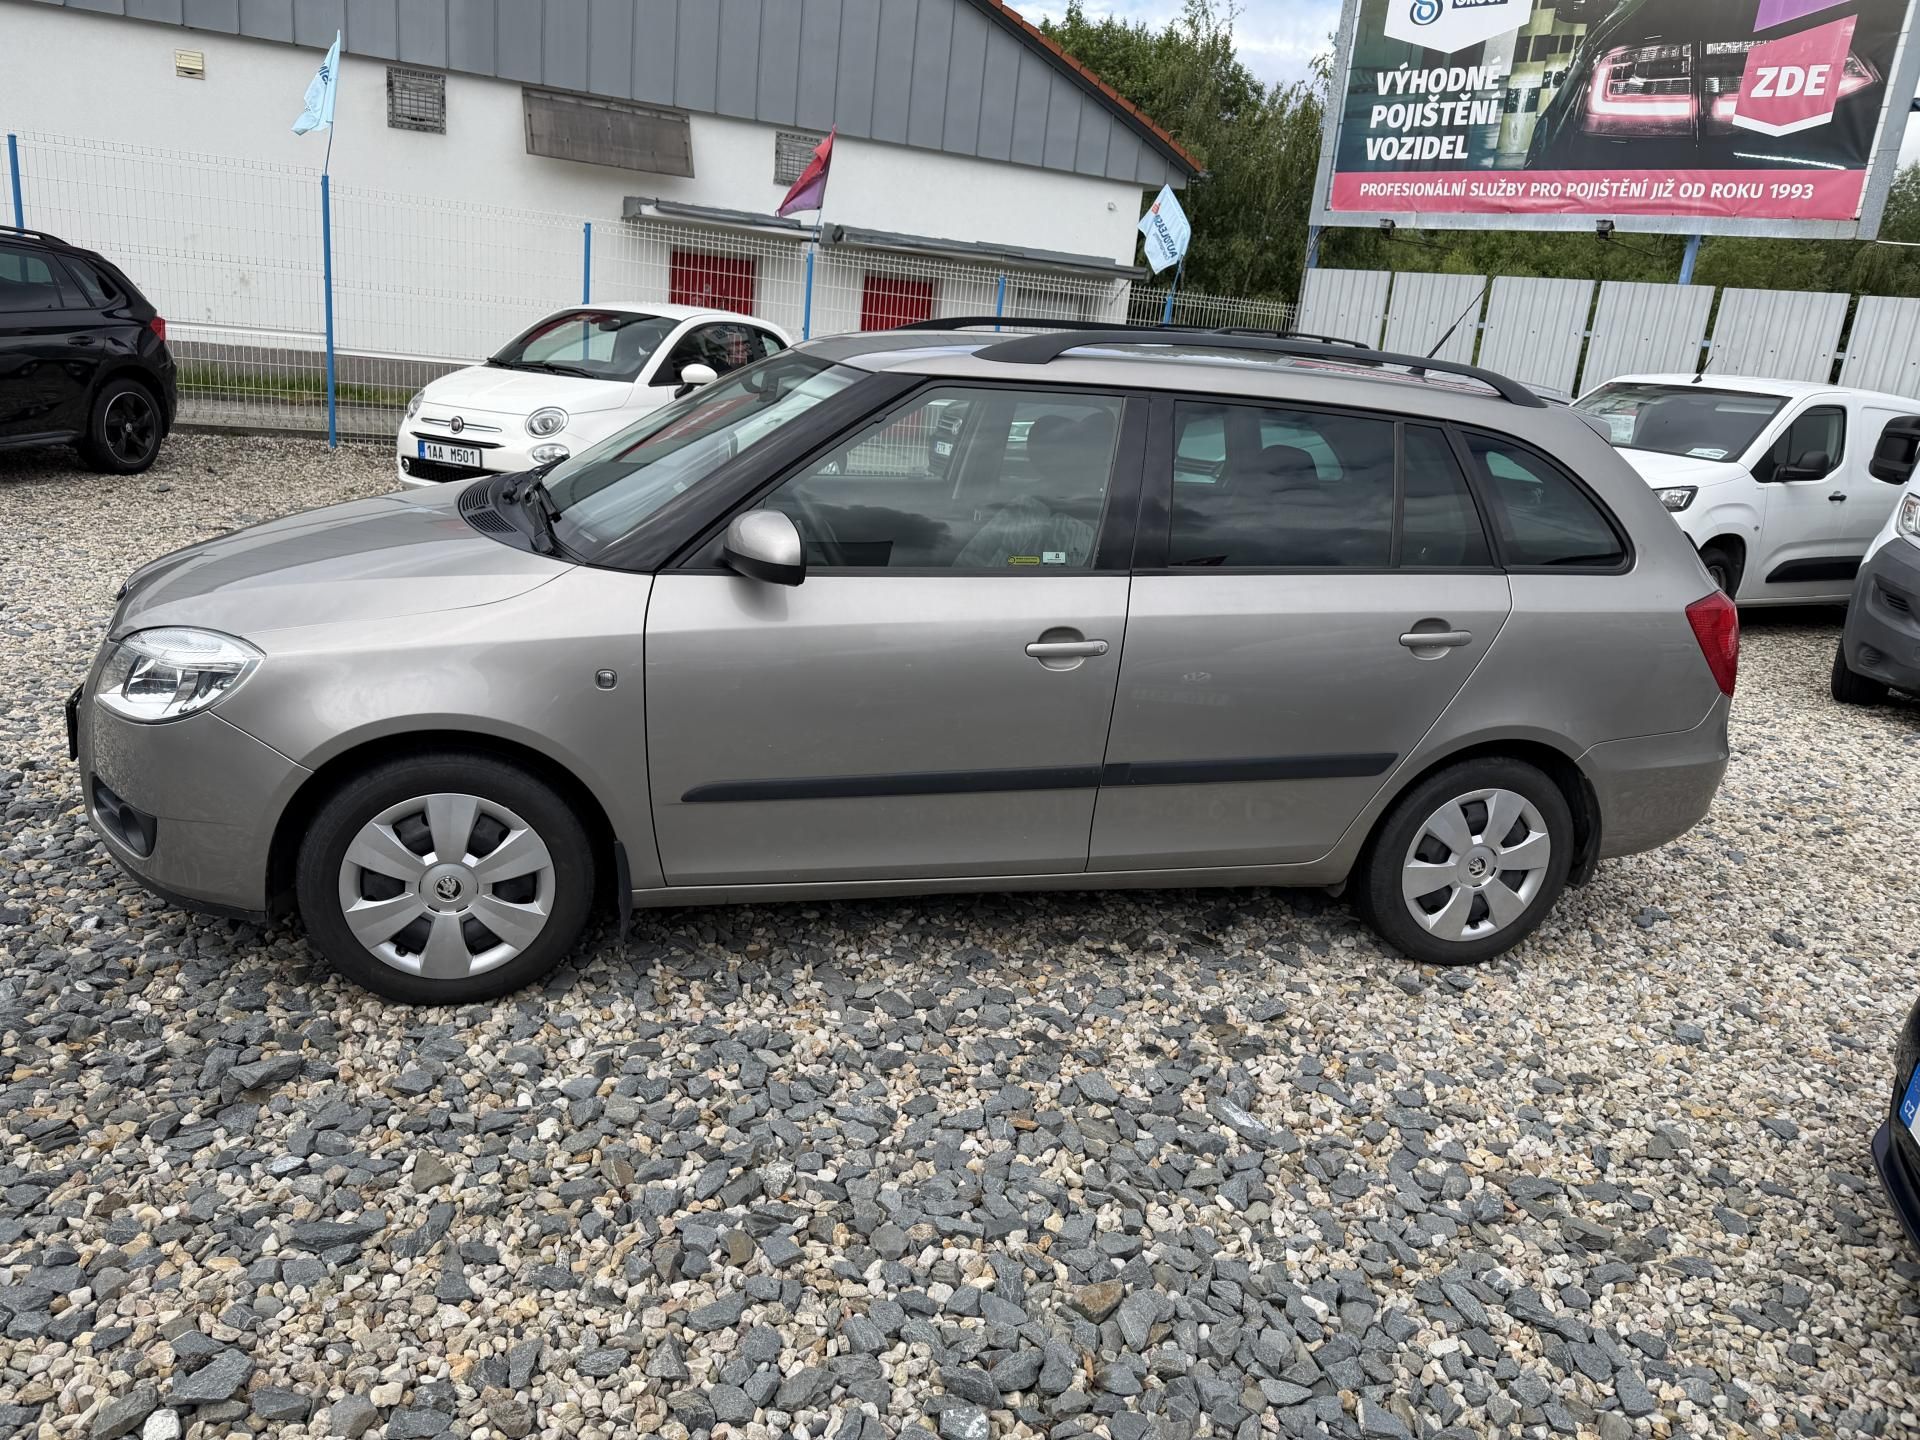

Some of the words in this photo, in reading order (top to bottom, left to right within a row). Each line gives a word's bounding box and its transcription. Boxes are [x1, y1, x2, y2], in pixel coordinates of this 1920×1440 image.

[1377, 56, 1502, 96] VÝHODNÉ
[1750, 64, 1831, 98] ZDE
[1370, 91, 1500, 133] POJIŠTĚNÍ
[1366, 135, 1468, 161] VOZIDEL
[1360, 179, 1467, 196] PROFESIONÁLNÍ
[1469, 179, 1526, 197] SLUŽBY
[1530, 182, 1561, 197] PRO
[1566, 179, 1648, 200] POJIŠTĚNÍ
[1651, 179, 1675, 200] JIŽ
[1679, 183, 1705, 198] OD
[1710, 183, 1764, 199] ROKU
[1769, 183, 1814, 199] 1993
[427, 444, 444, 460] 1AA
[450, 448, 475, 465] M501
[1904, 1100, 1915, 1120] CZ
